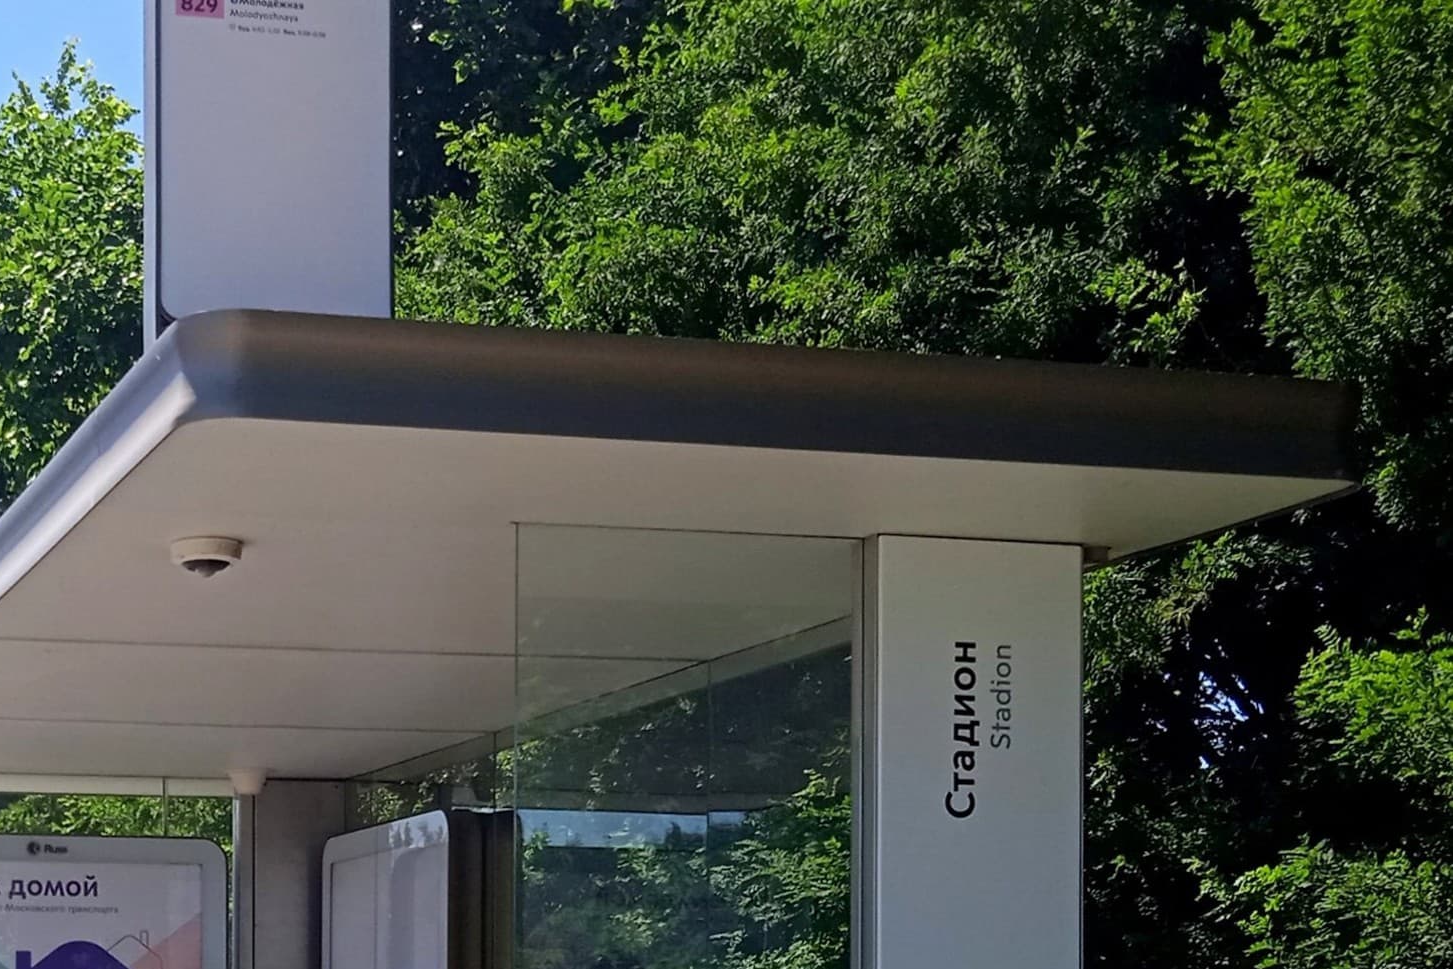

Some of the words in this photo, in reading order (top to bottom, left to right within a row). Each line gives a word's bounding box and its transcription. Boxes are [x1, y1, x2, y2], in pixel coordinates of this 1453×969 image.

[180, 0, 218, 13] 829
[990, 644, 1012, 749] Stadion
[945, 641, 980, 818] Стадион
[8, 875, 99, 900] домой
